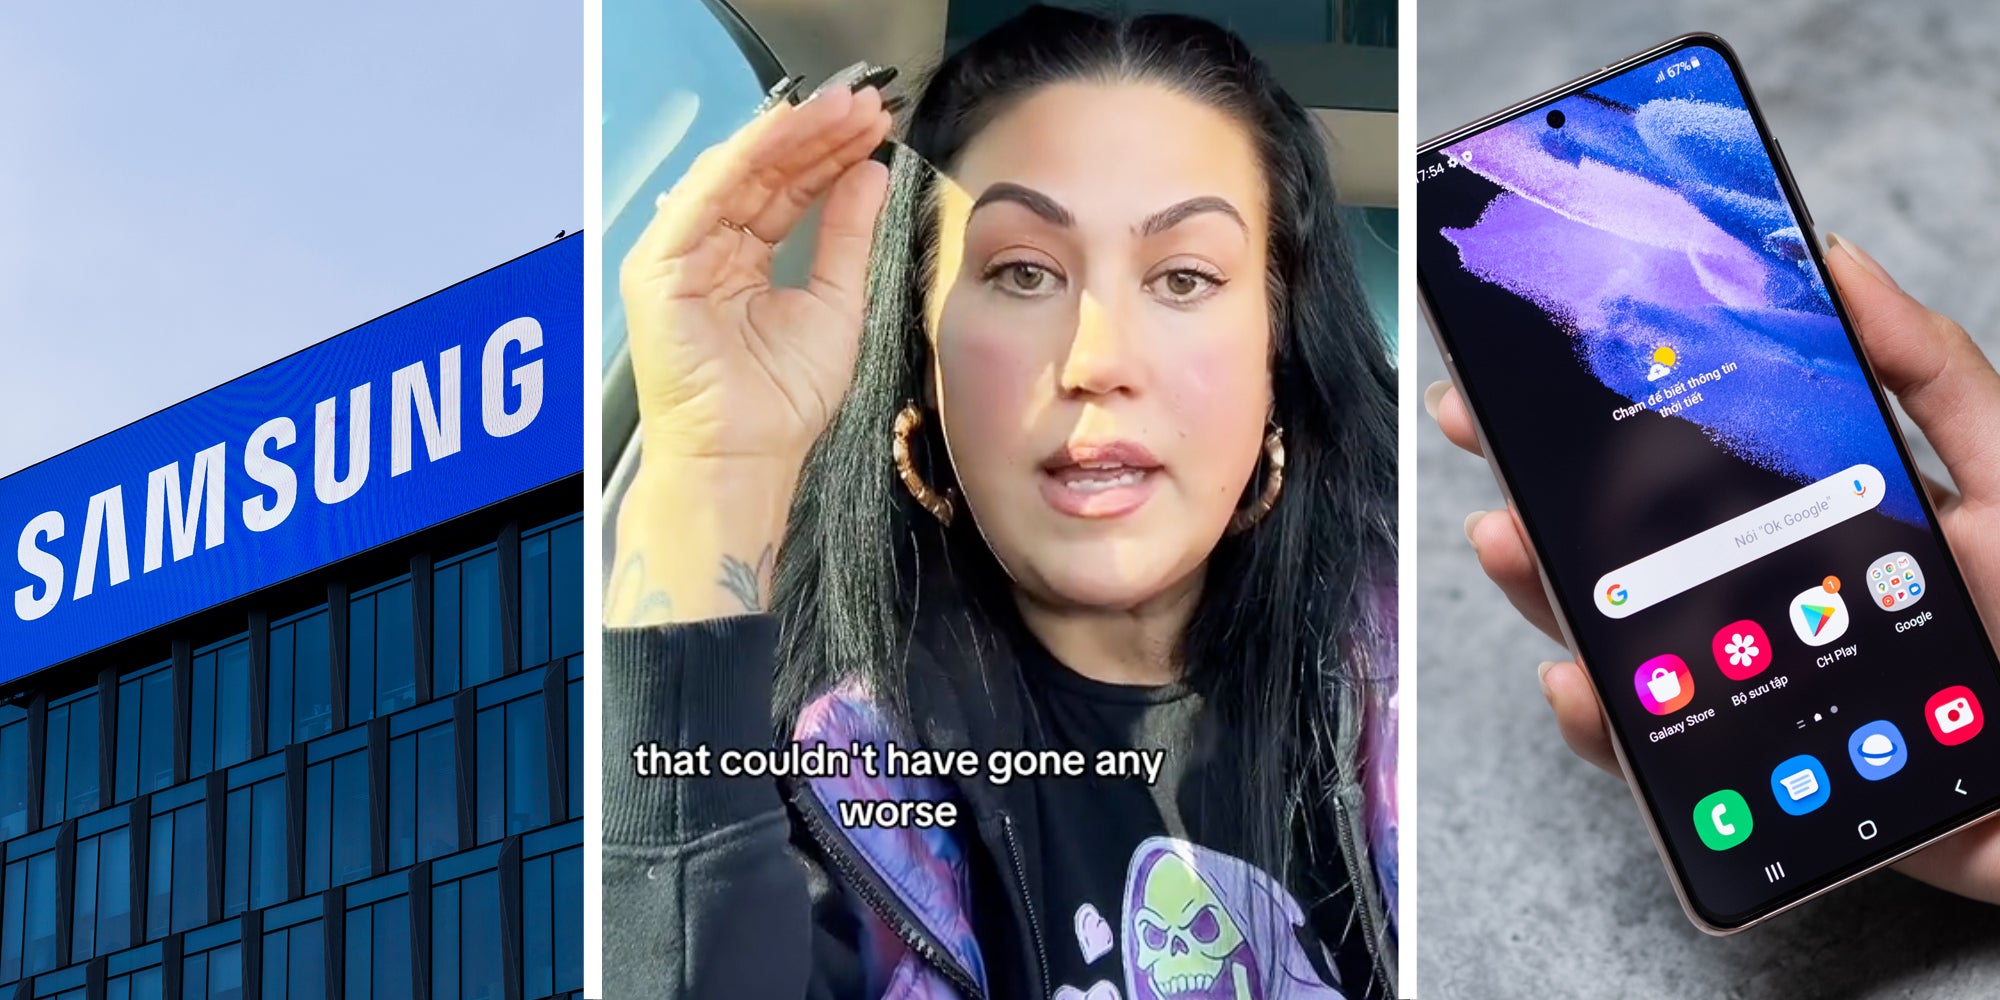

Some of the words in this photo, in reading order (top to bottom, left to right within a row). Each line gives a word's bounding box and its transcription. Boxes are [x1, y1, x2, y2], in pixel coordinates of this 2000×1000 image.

[1667, 61, 1691, 78] 67%
[1612, 401, 1646, 421] Chạm
[1663, 381, 1687, 399] biết
[1687, 369, 1721, 389] thông
[1721, 362, 1738, 374] tin
[1660, 400, 1683, 418] thời
[1683, 391, 1704, 408] tiết
[15, 316, 544, 621] SAMSUNG
[1734, 529, 1758, 548] Nói
[1895, 611, 1933, 633] Google
[1816, 653, 1834, 668] CH
[1834, 644, 1858, 660] Play
[1731, 691, 1747, 707] Bộ
[1748, 684, 1770, 699] sưu
[1769, 675, 1789, 689] tập
[1649, 721, 1685, 743] Galaxy
[1686, 708, 1716, 727] Store
